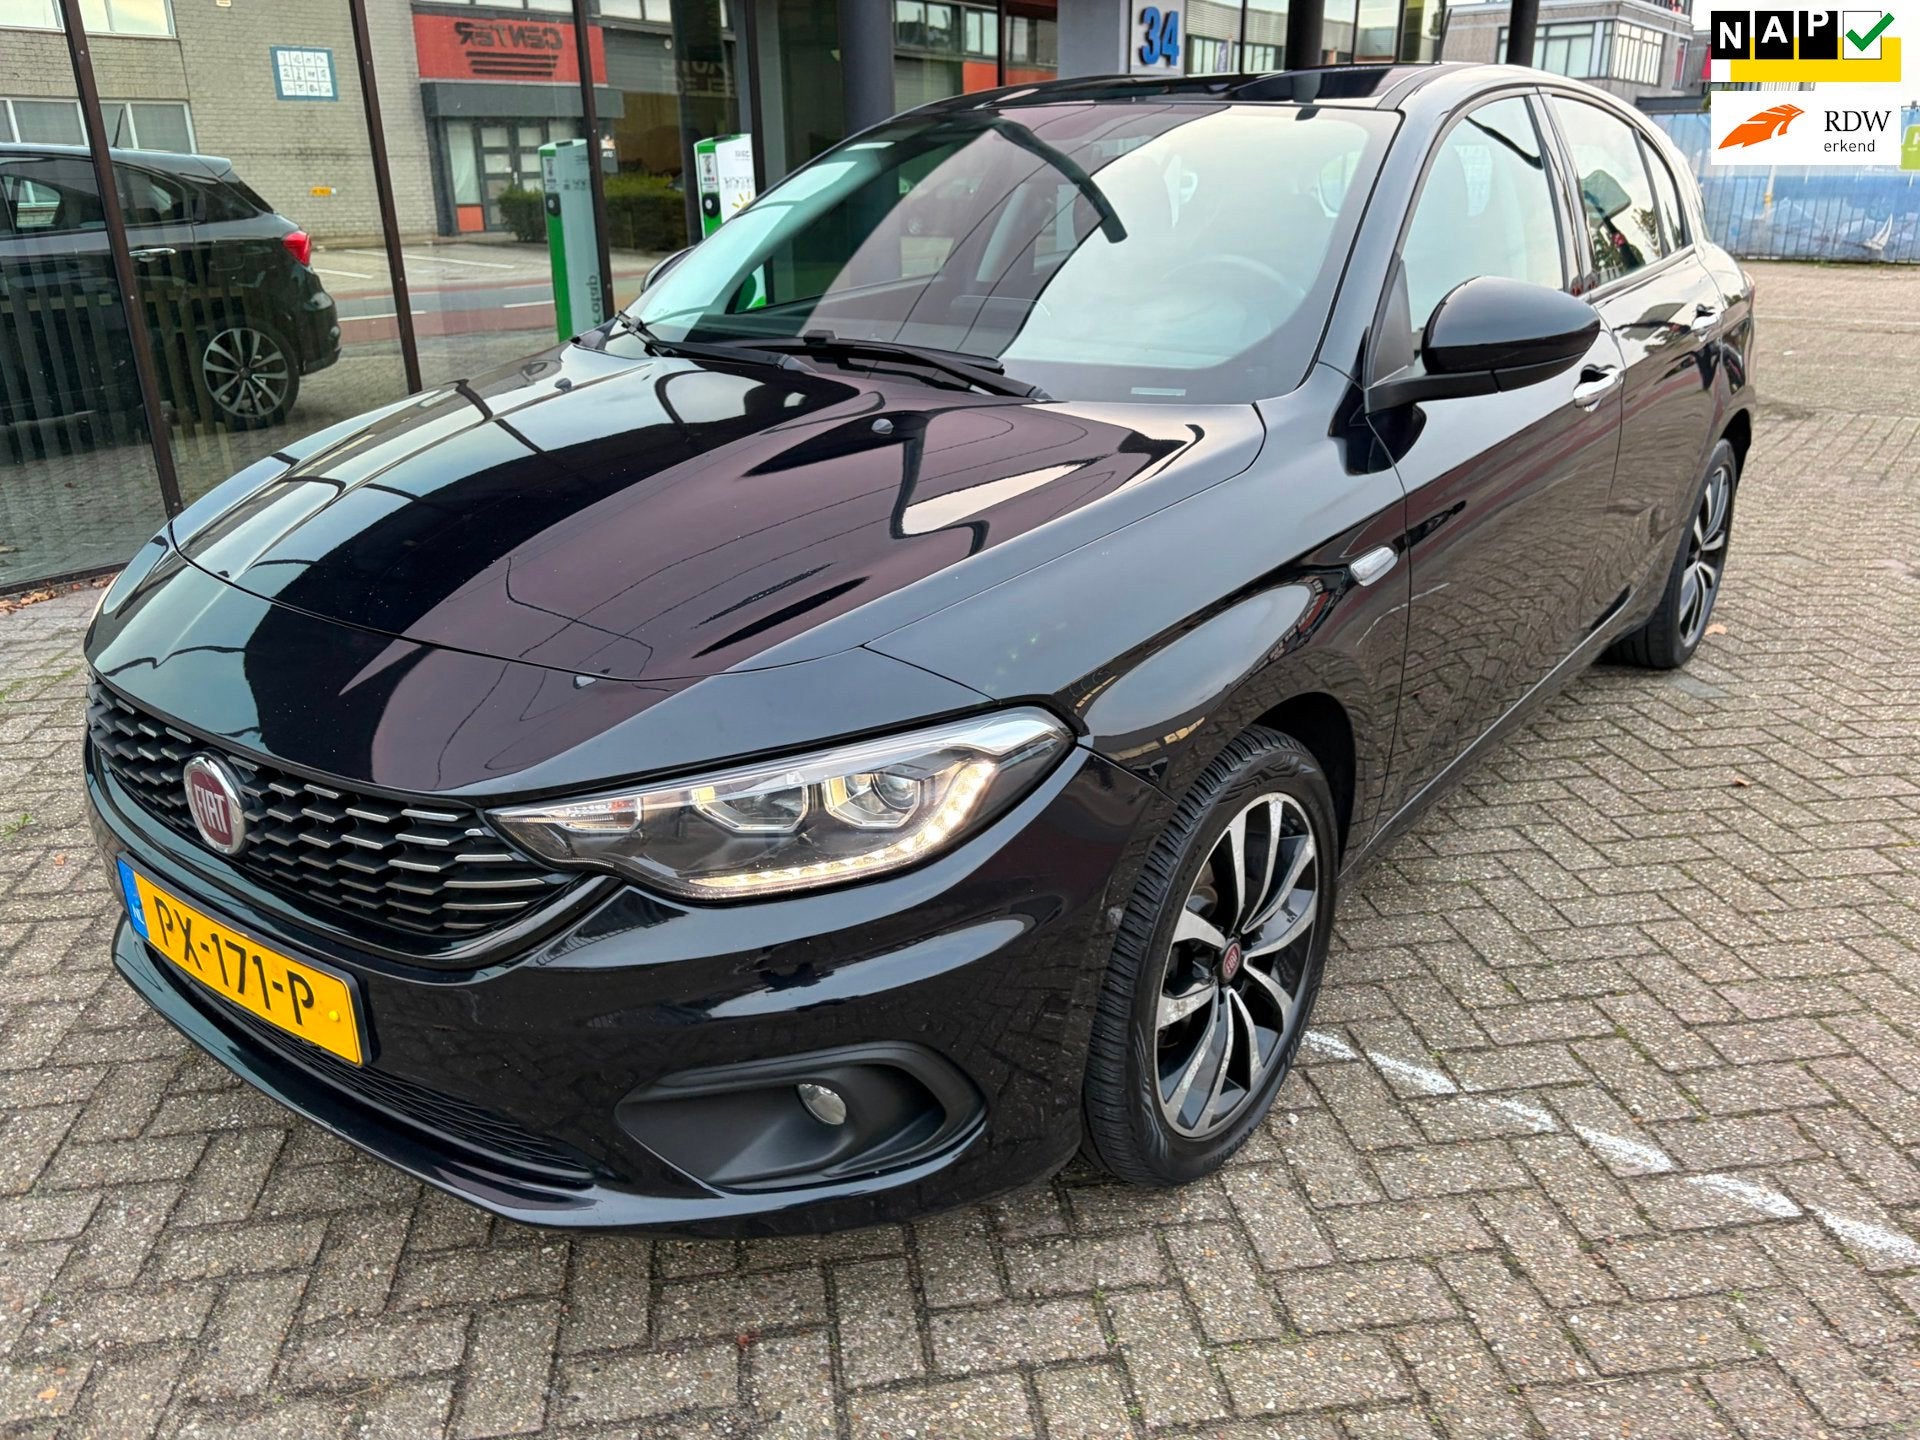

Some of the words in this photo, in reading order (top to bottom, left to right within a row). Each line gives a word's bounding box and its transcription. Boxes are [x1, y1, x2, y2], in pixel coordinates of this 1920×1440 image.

[1139, 6, 1179, 66] 34
[193, 783, 229, 835] FIAT
[131, 903, 146, 926] NL
[153, 895, 315, 1026] PX-171-P
